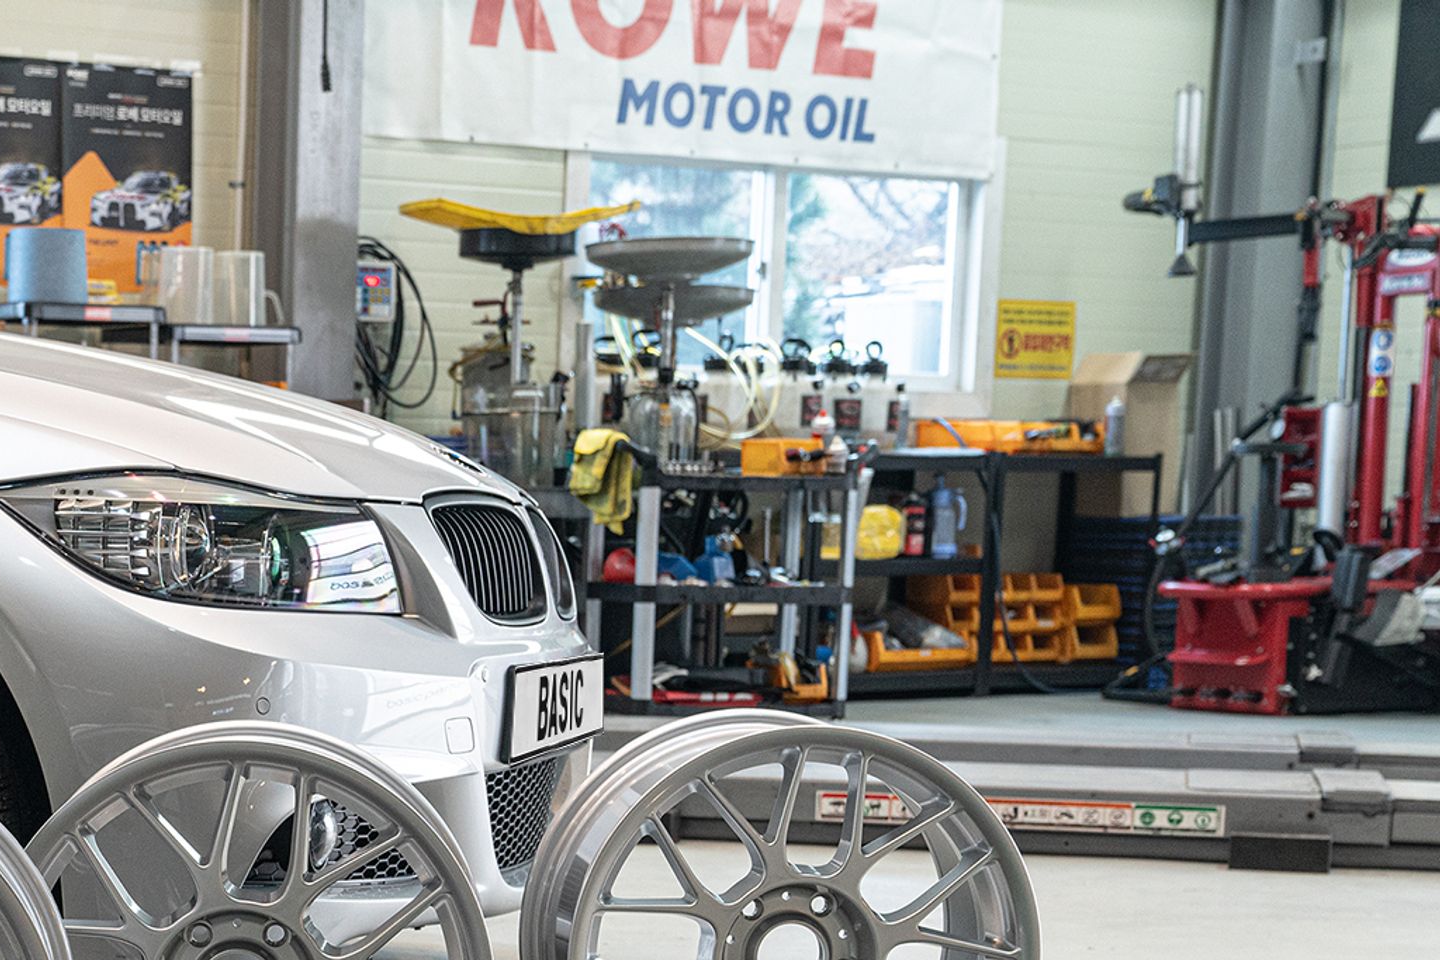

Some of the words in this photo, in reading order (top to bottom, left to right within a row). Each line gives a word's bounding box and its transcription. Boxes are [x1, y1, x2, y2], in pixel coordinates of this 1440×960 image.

[616, 77, 791, 137] MOTOR
[805, 94, 876, 143] OIL
[537, 669, 584, 741] BASIC
